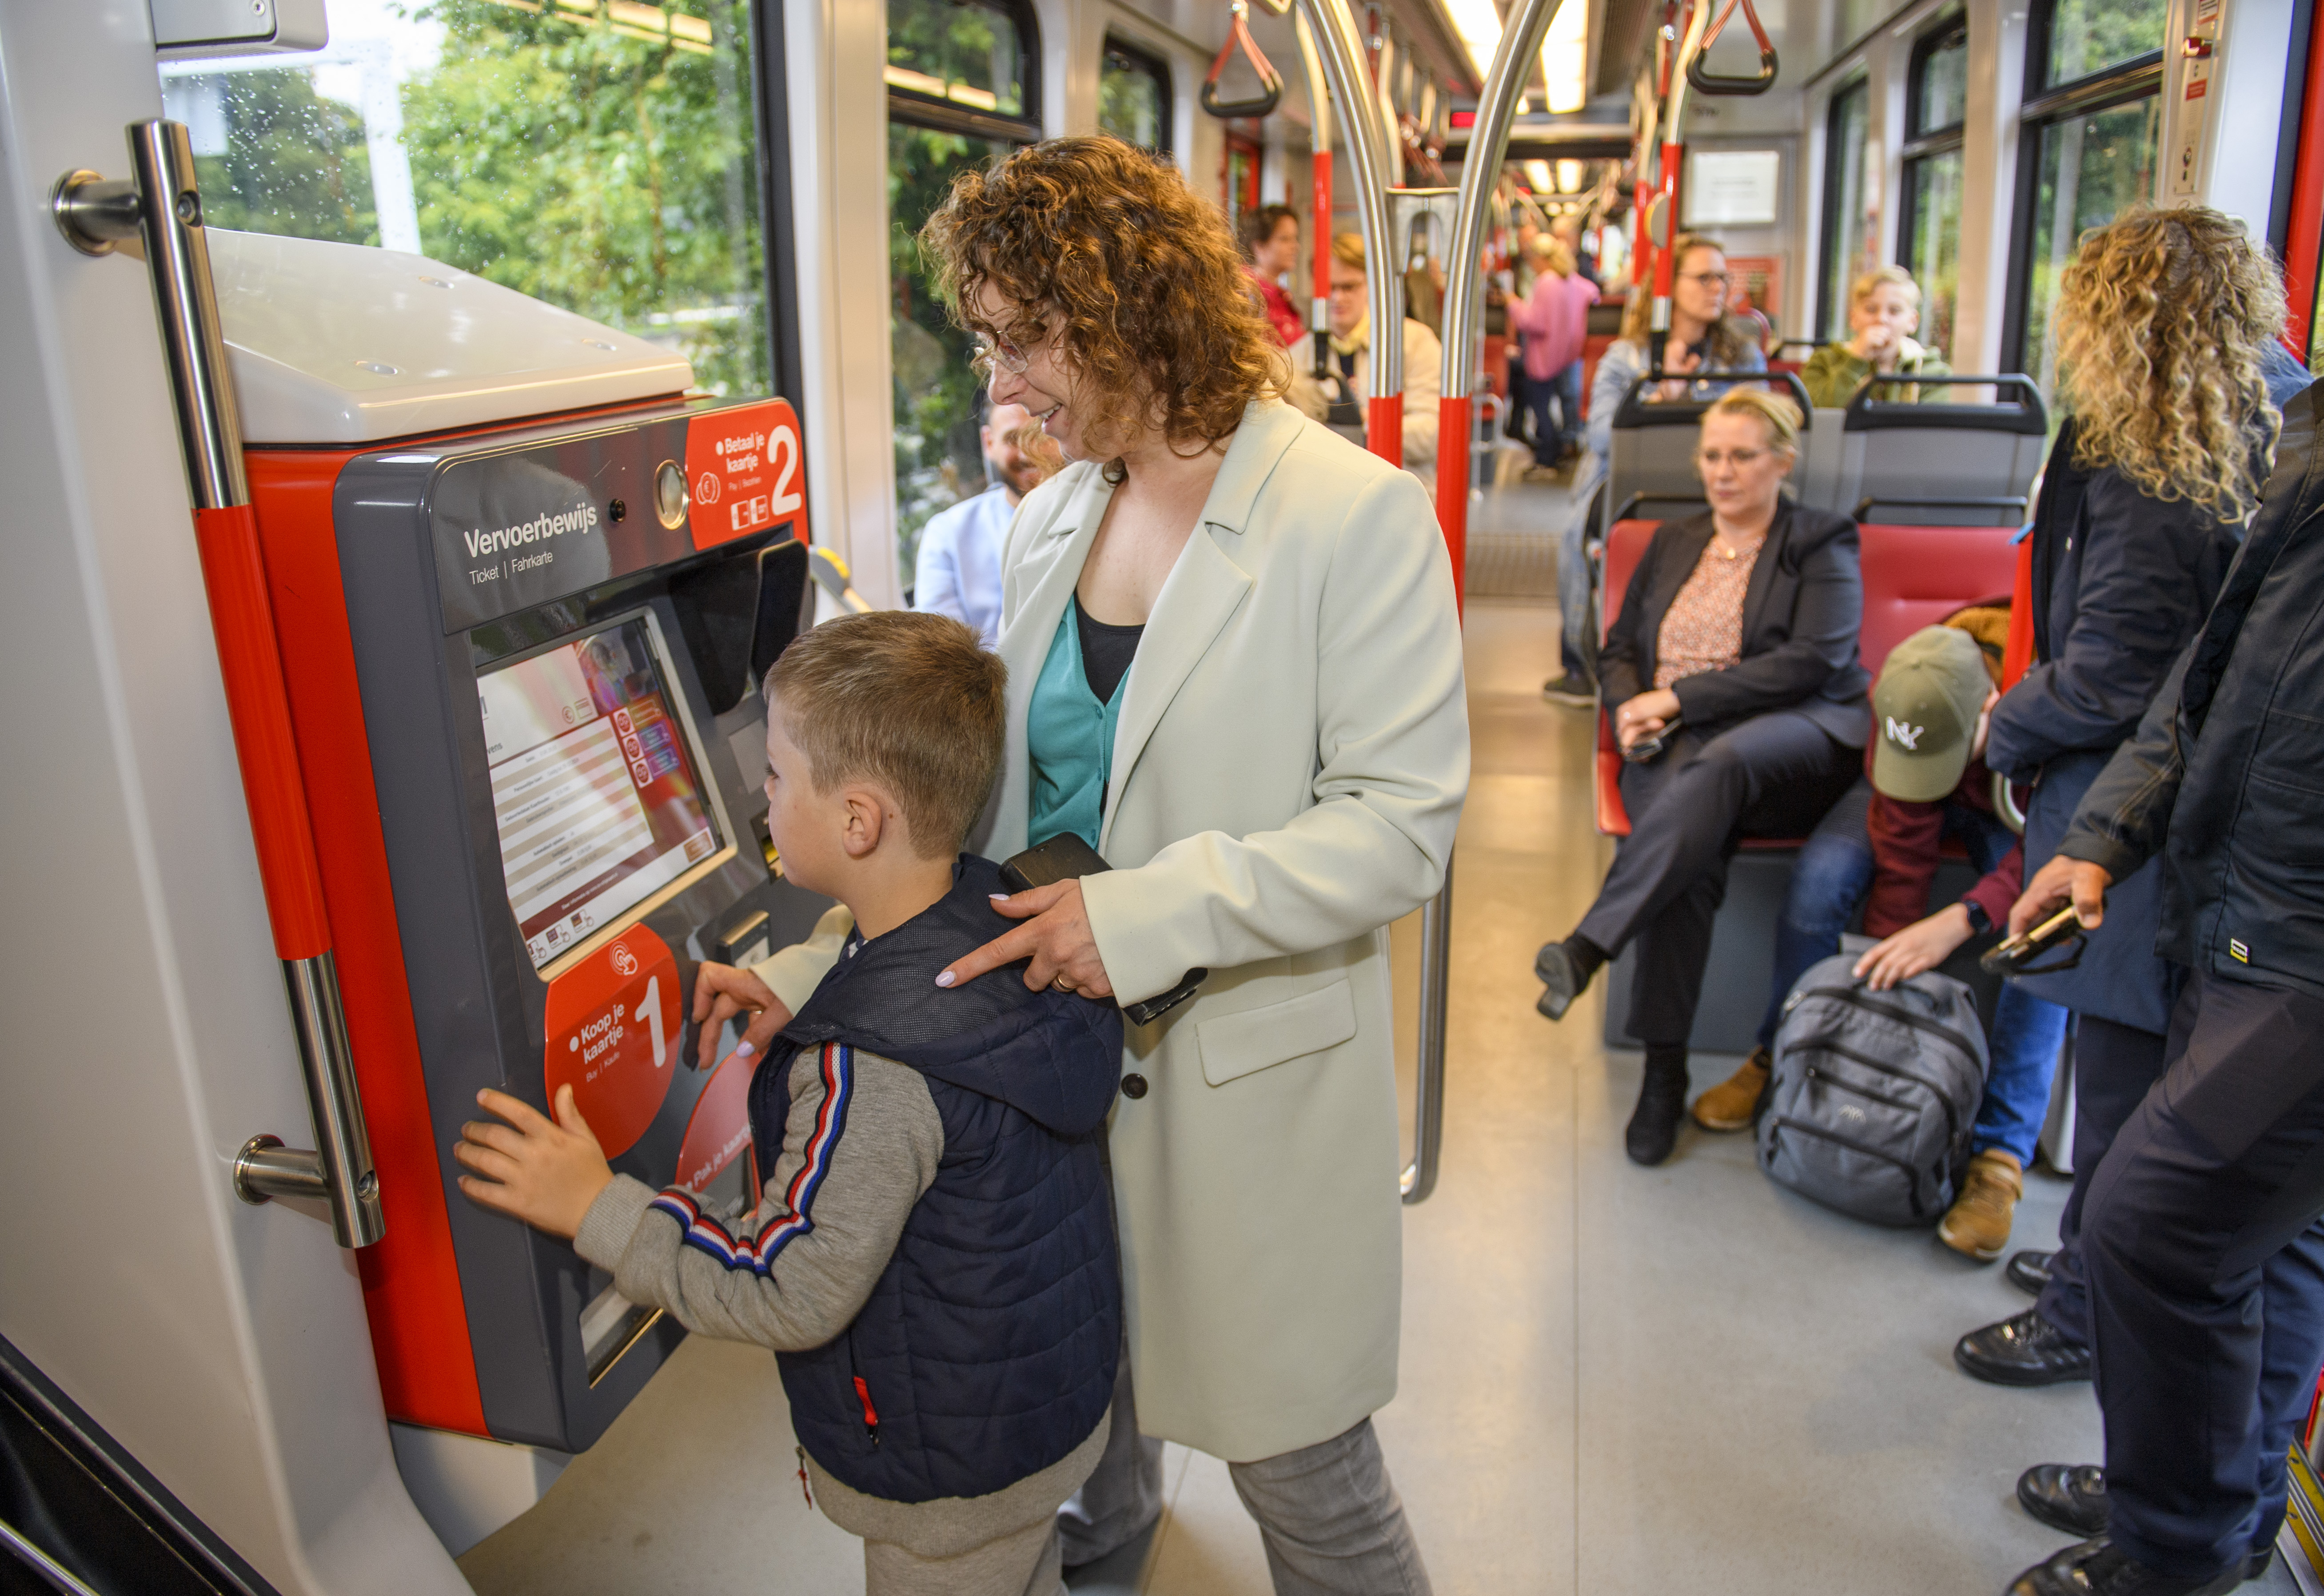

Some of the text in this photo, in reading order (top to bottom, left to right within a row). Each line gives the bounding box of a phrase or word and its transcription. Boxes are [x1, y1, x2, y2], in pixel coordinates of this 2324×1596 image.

[725, 431, 765, 454] Betaal je
[726, 452, 759, 473] kaartje
[767, 424, 801, 516] 2
[464, 502, 598, 557] Vervoerbewijs
[469, 551, 553, 585] Ticket Fahrkarte
[1886, 716, 1924, 749] NY
[581, 1003, 625, 1045] Koop je
[635, 975, 666, 1068] 1
[583, 1025, 624, 1065] kaartje
[586, 1069, 598, 1083] Buy
[694, 1162, 712, 1187] Pak
[713, 1153, 722, 1172] je
